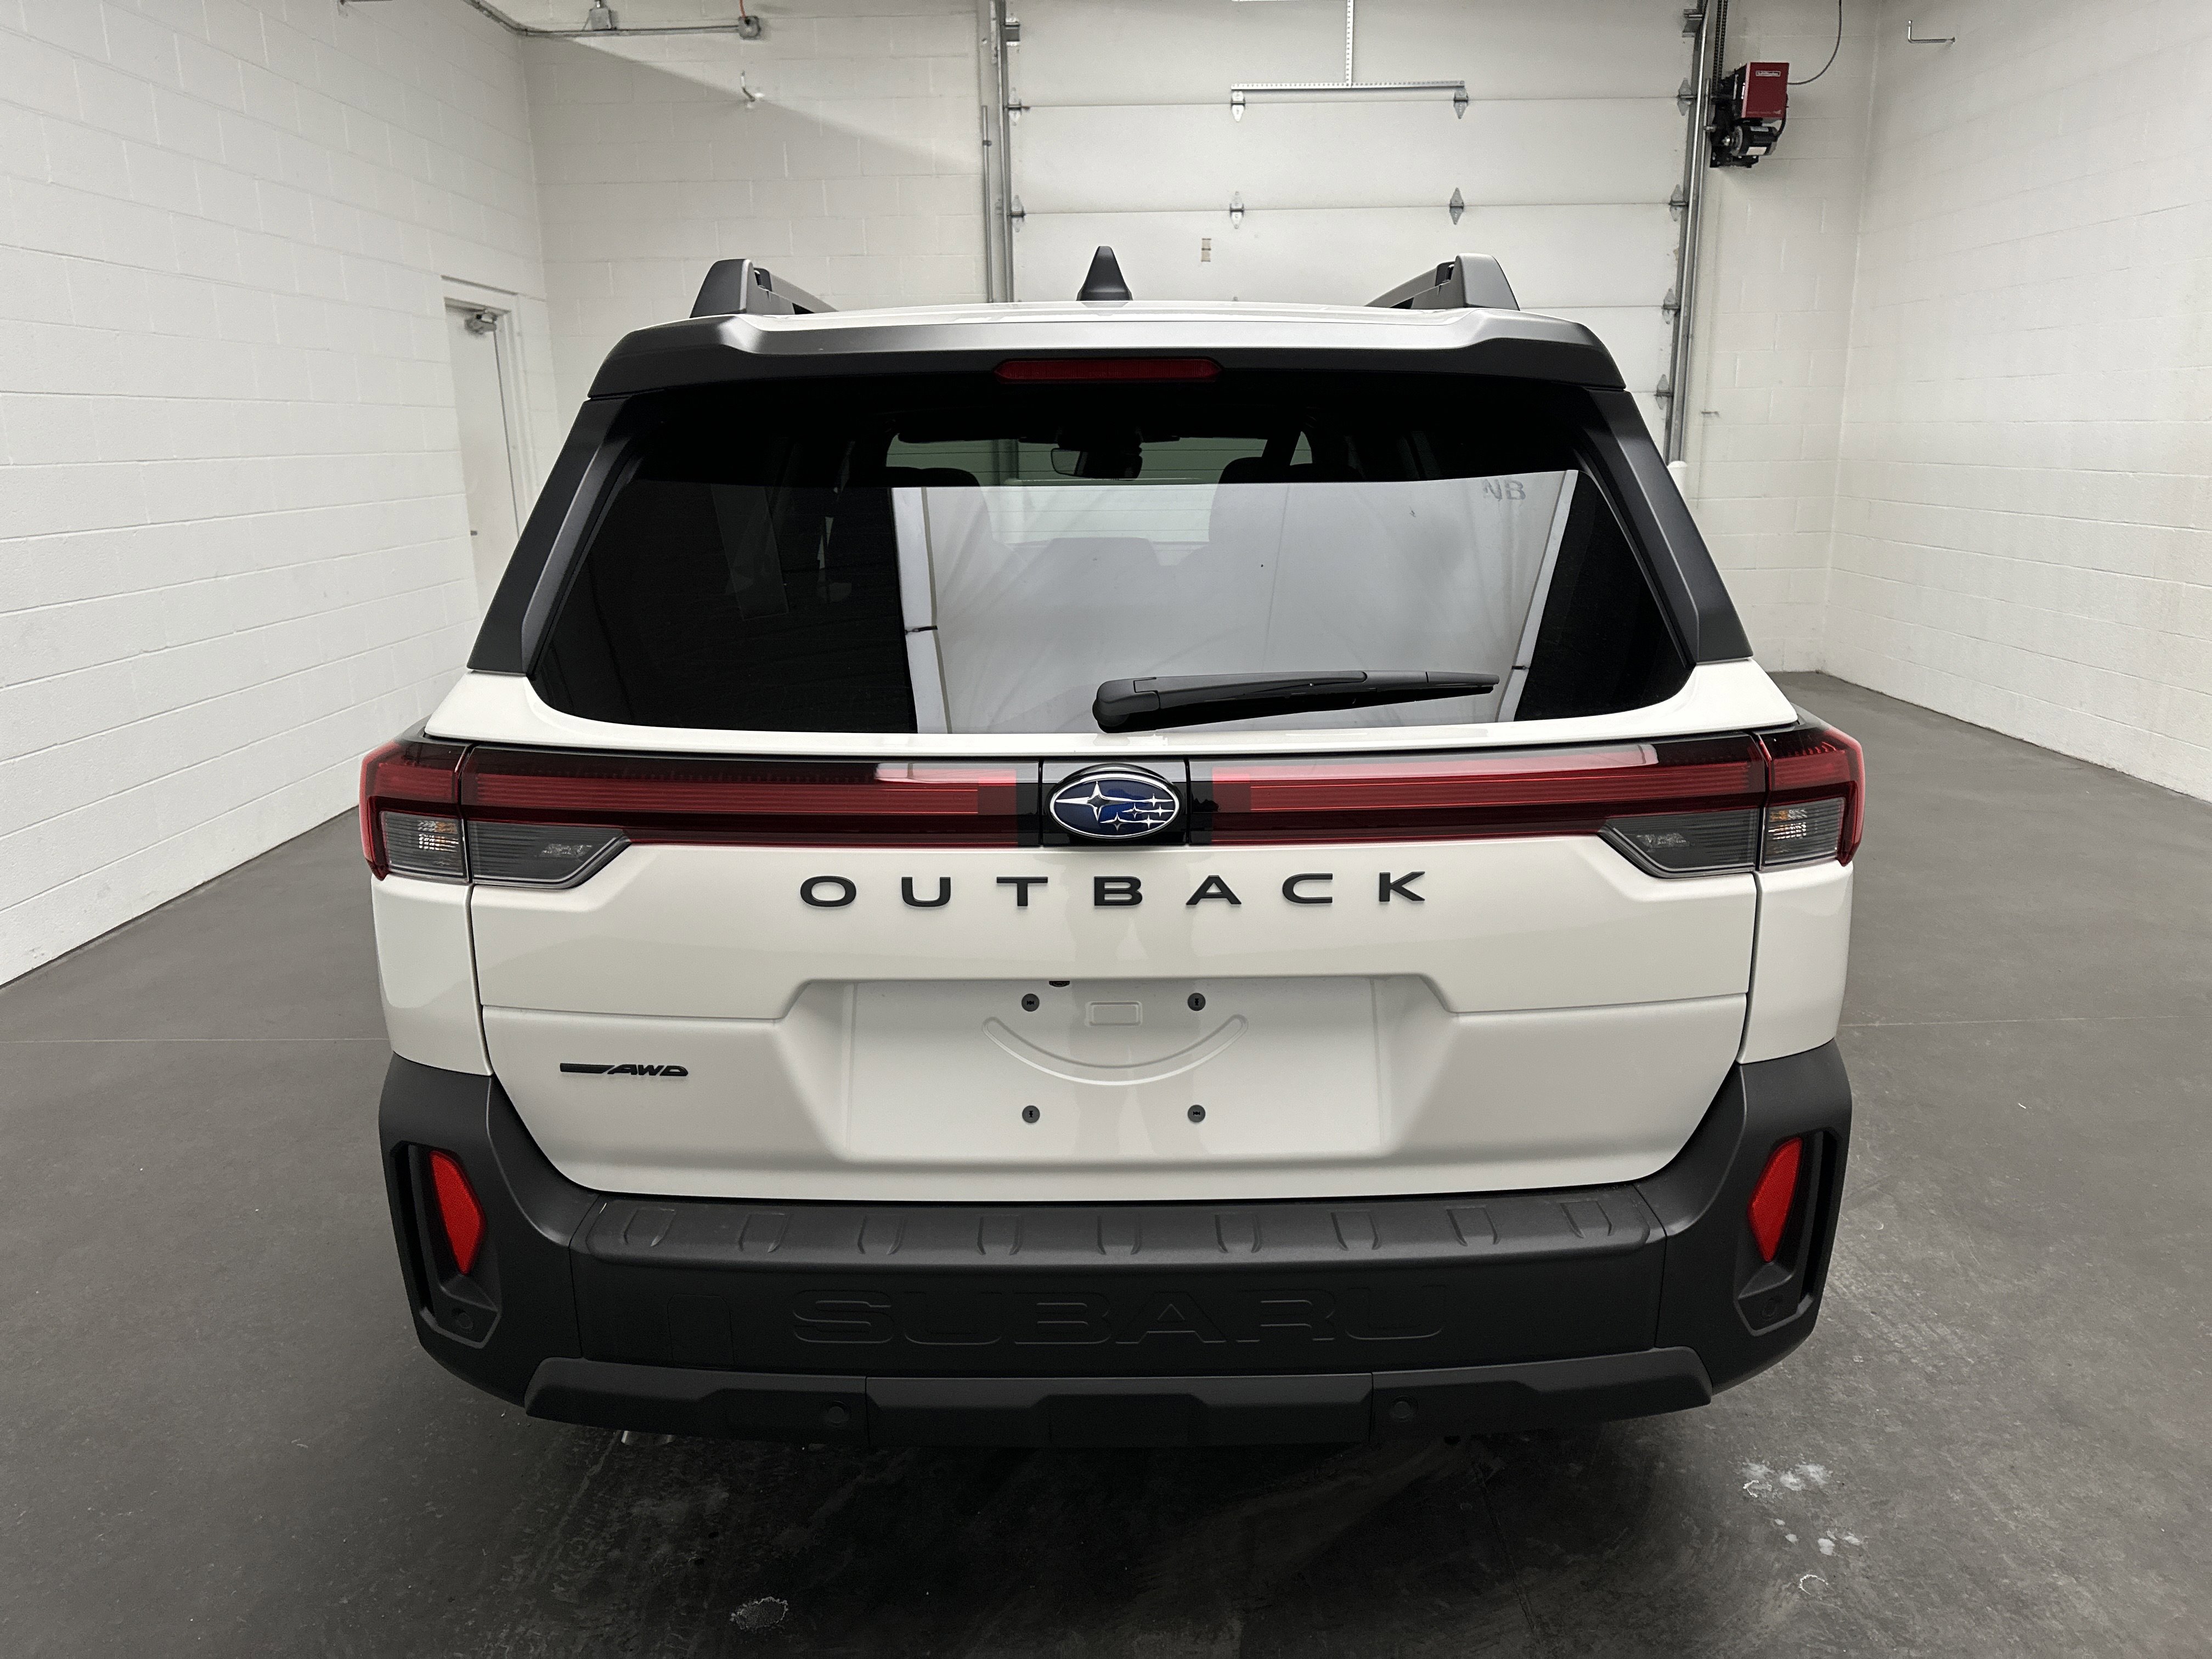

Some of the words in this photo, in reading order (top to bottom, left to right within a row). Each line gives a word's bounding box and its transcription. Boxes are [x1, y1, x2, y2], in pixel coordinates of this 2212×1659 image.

[800, 871, 1425, 908] OUTBACK
[607, 1064, 689, 1076] AWD
[793, 1285, 1448, 1345] SUBARU
